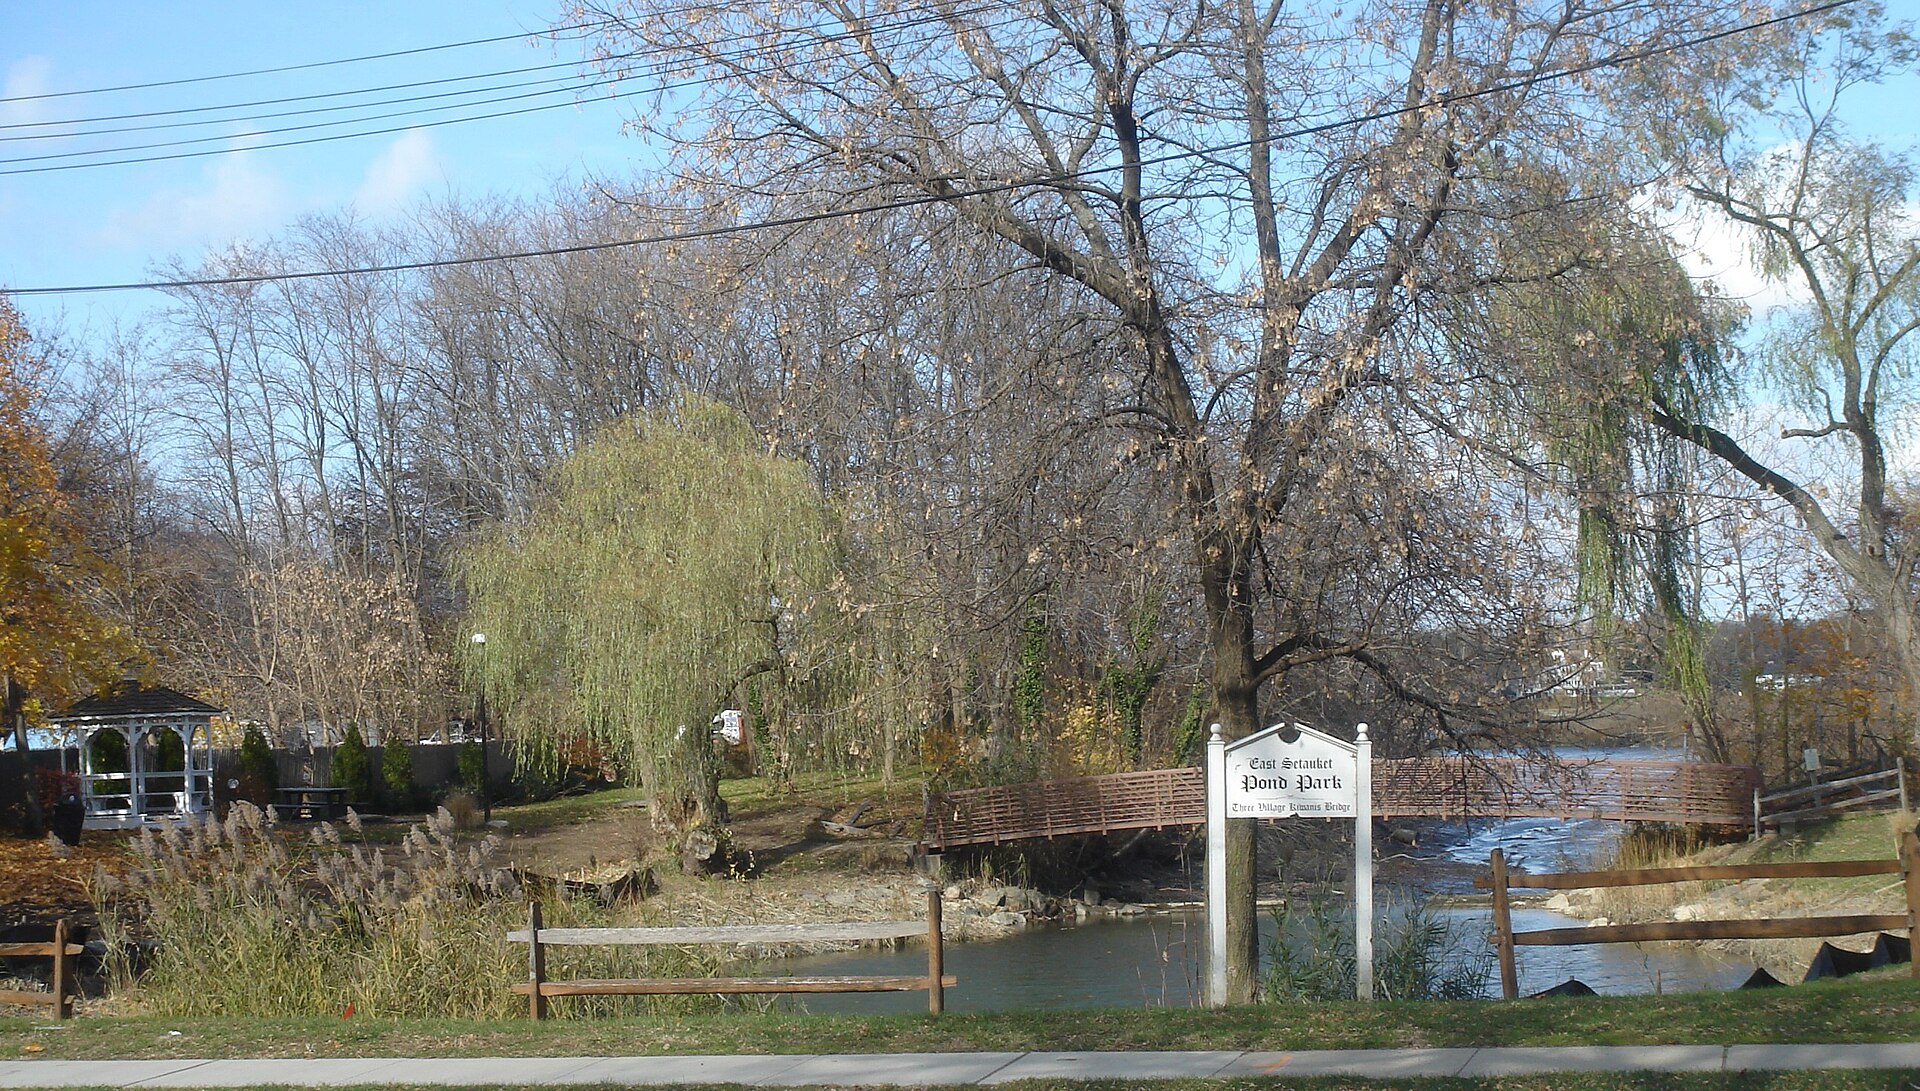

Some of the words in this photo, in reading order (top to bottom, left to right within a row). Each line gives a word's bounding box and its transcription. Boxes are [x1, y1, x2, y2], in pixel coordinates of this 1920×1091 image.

[1249, 757, 1277, 770] East
[1240, 774, 1288, 792] Pond
[1296, 774, 1343, 792] Park
[1232, 803, 1255, 812] Three
[1258, 803, 1286, 813] Village
[1325, 802, 1351, 813] Bridge
